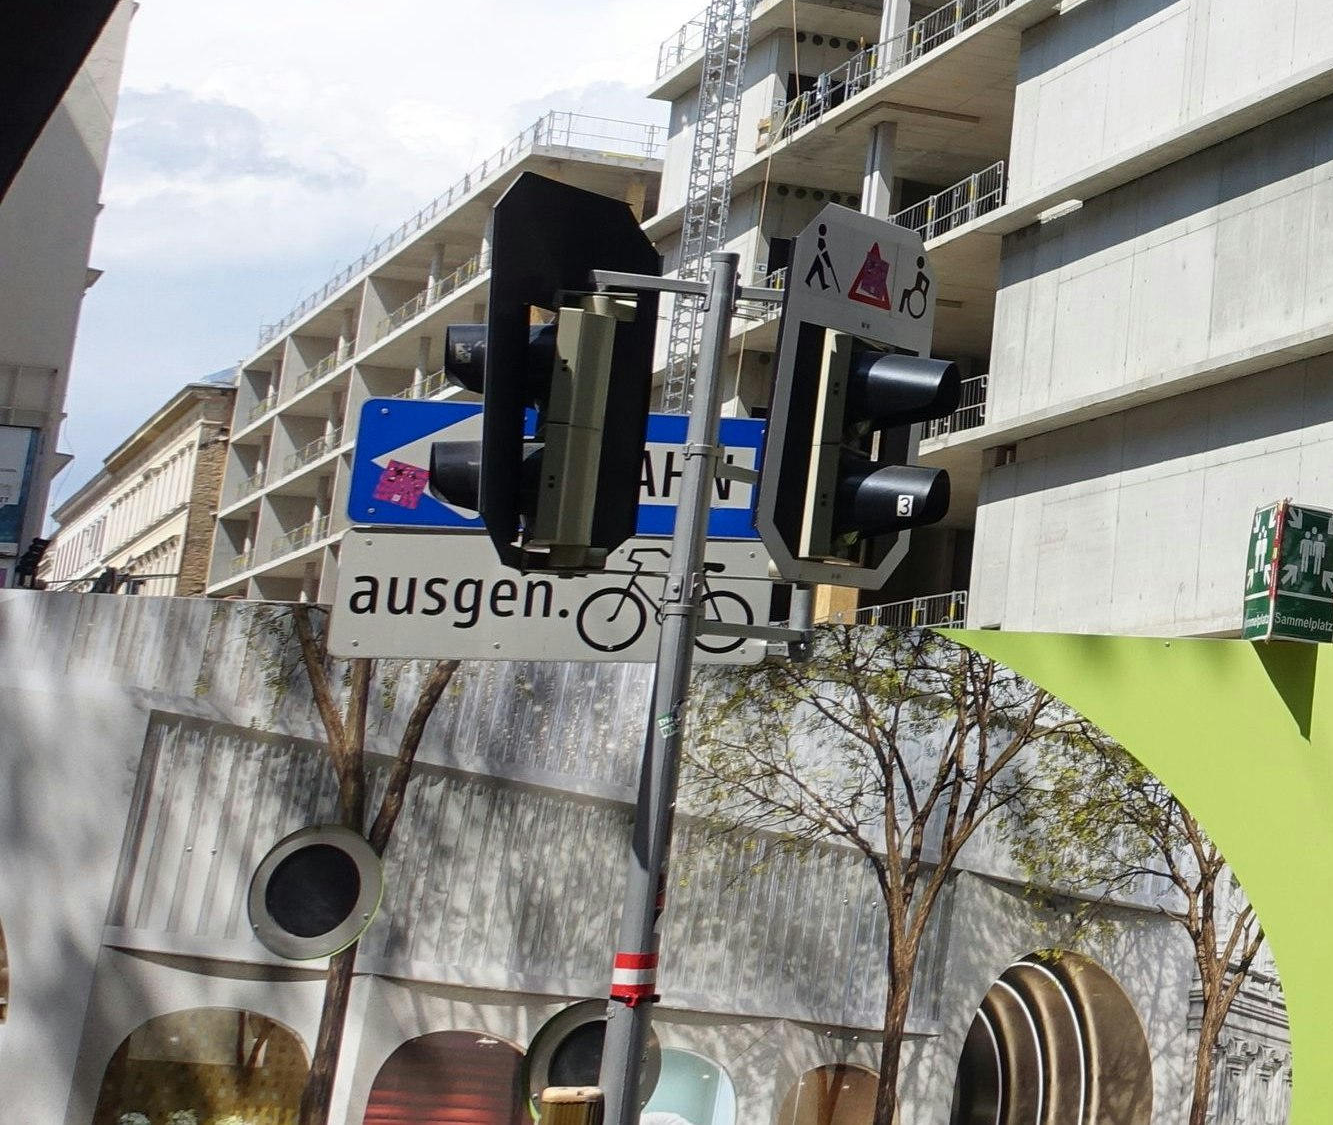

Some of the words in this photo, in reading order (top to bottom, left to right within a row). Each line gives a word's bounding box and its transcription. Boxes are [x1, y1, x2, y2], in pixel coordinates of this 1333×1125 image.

[899, 497, 911, 515] 3
[349, 575, 569, 629] ausgen.
[1274, 612, 1333, 632] Sammelplatz
